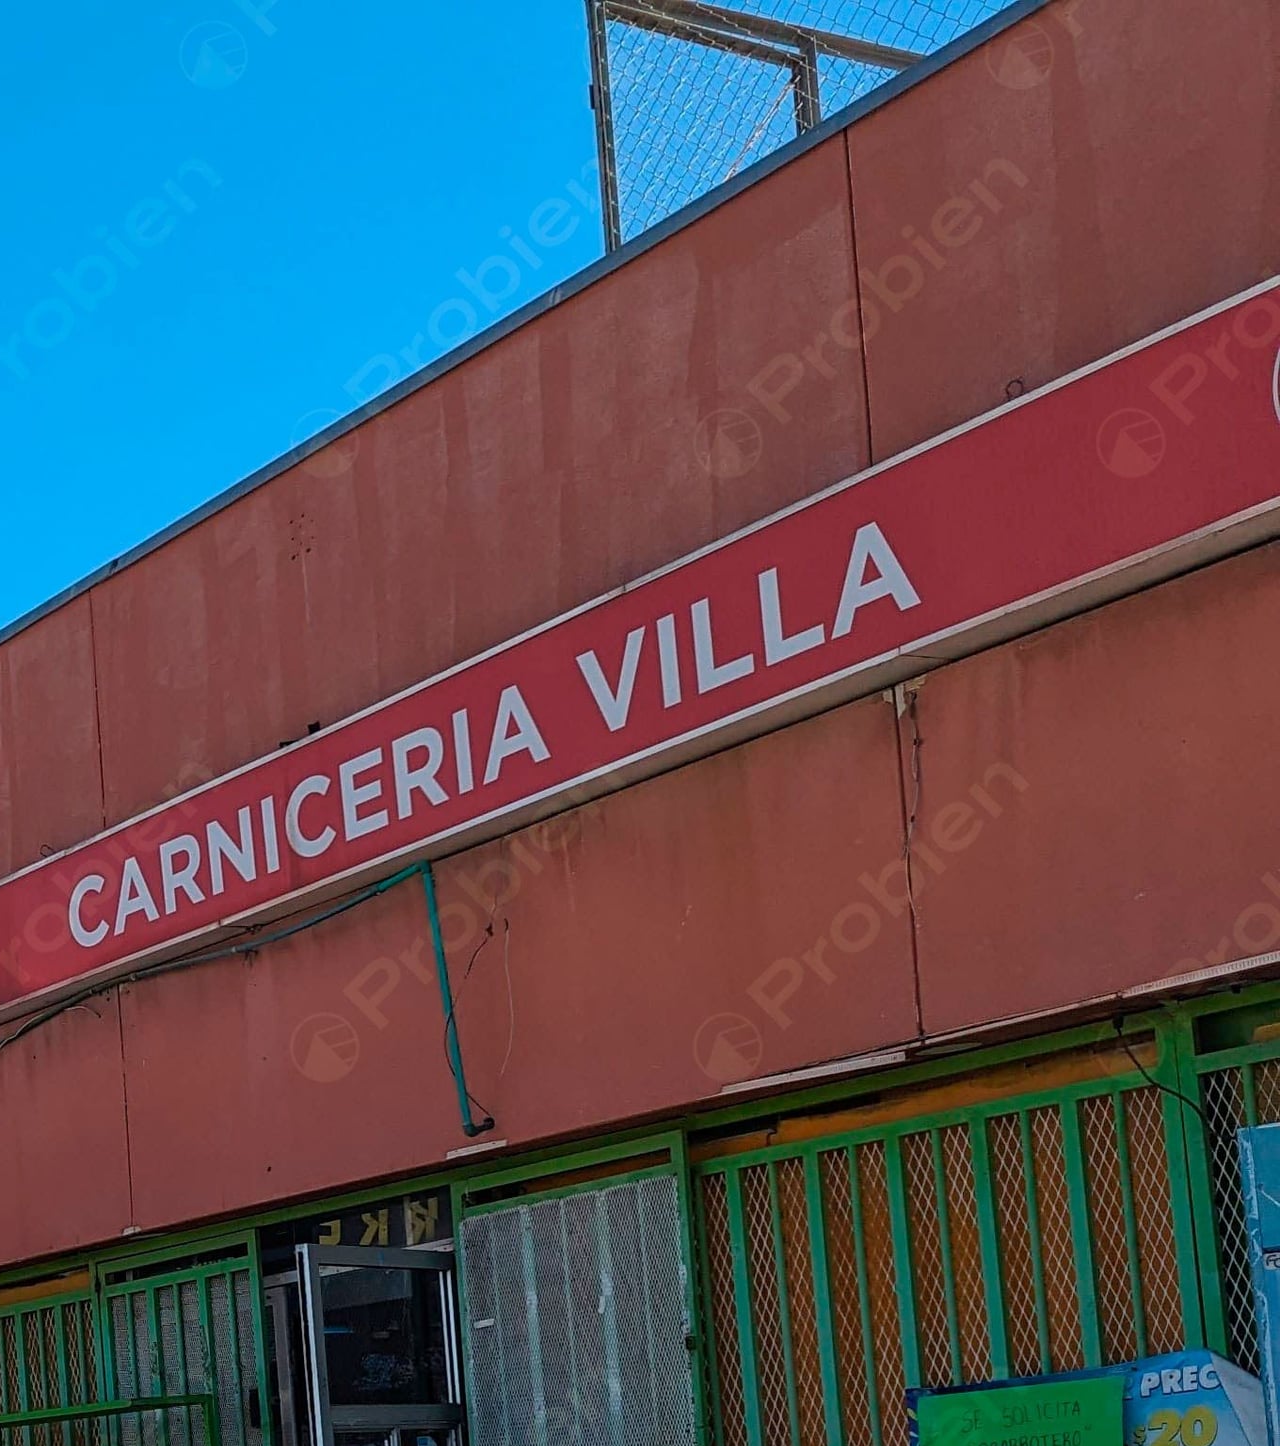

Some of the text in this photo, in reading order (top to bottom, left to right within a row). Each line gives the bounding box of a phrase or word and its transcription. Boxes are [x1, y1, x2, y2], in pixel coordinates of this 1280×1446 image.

[68, 520, 922, 948] CARNICERIA VILLA
[961, 1400, 1081, 1433] SE SOLICITA
